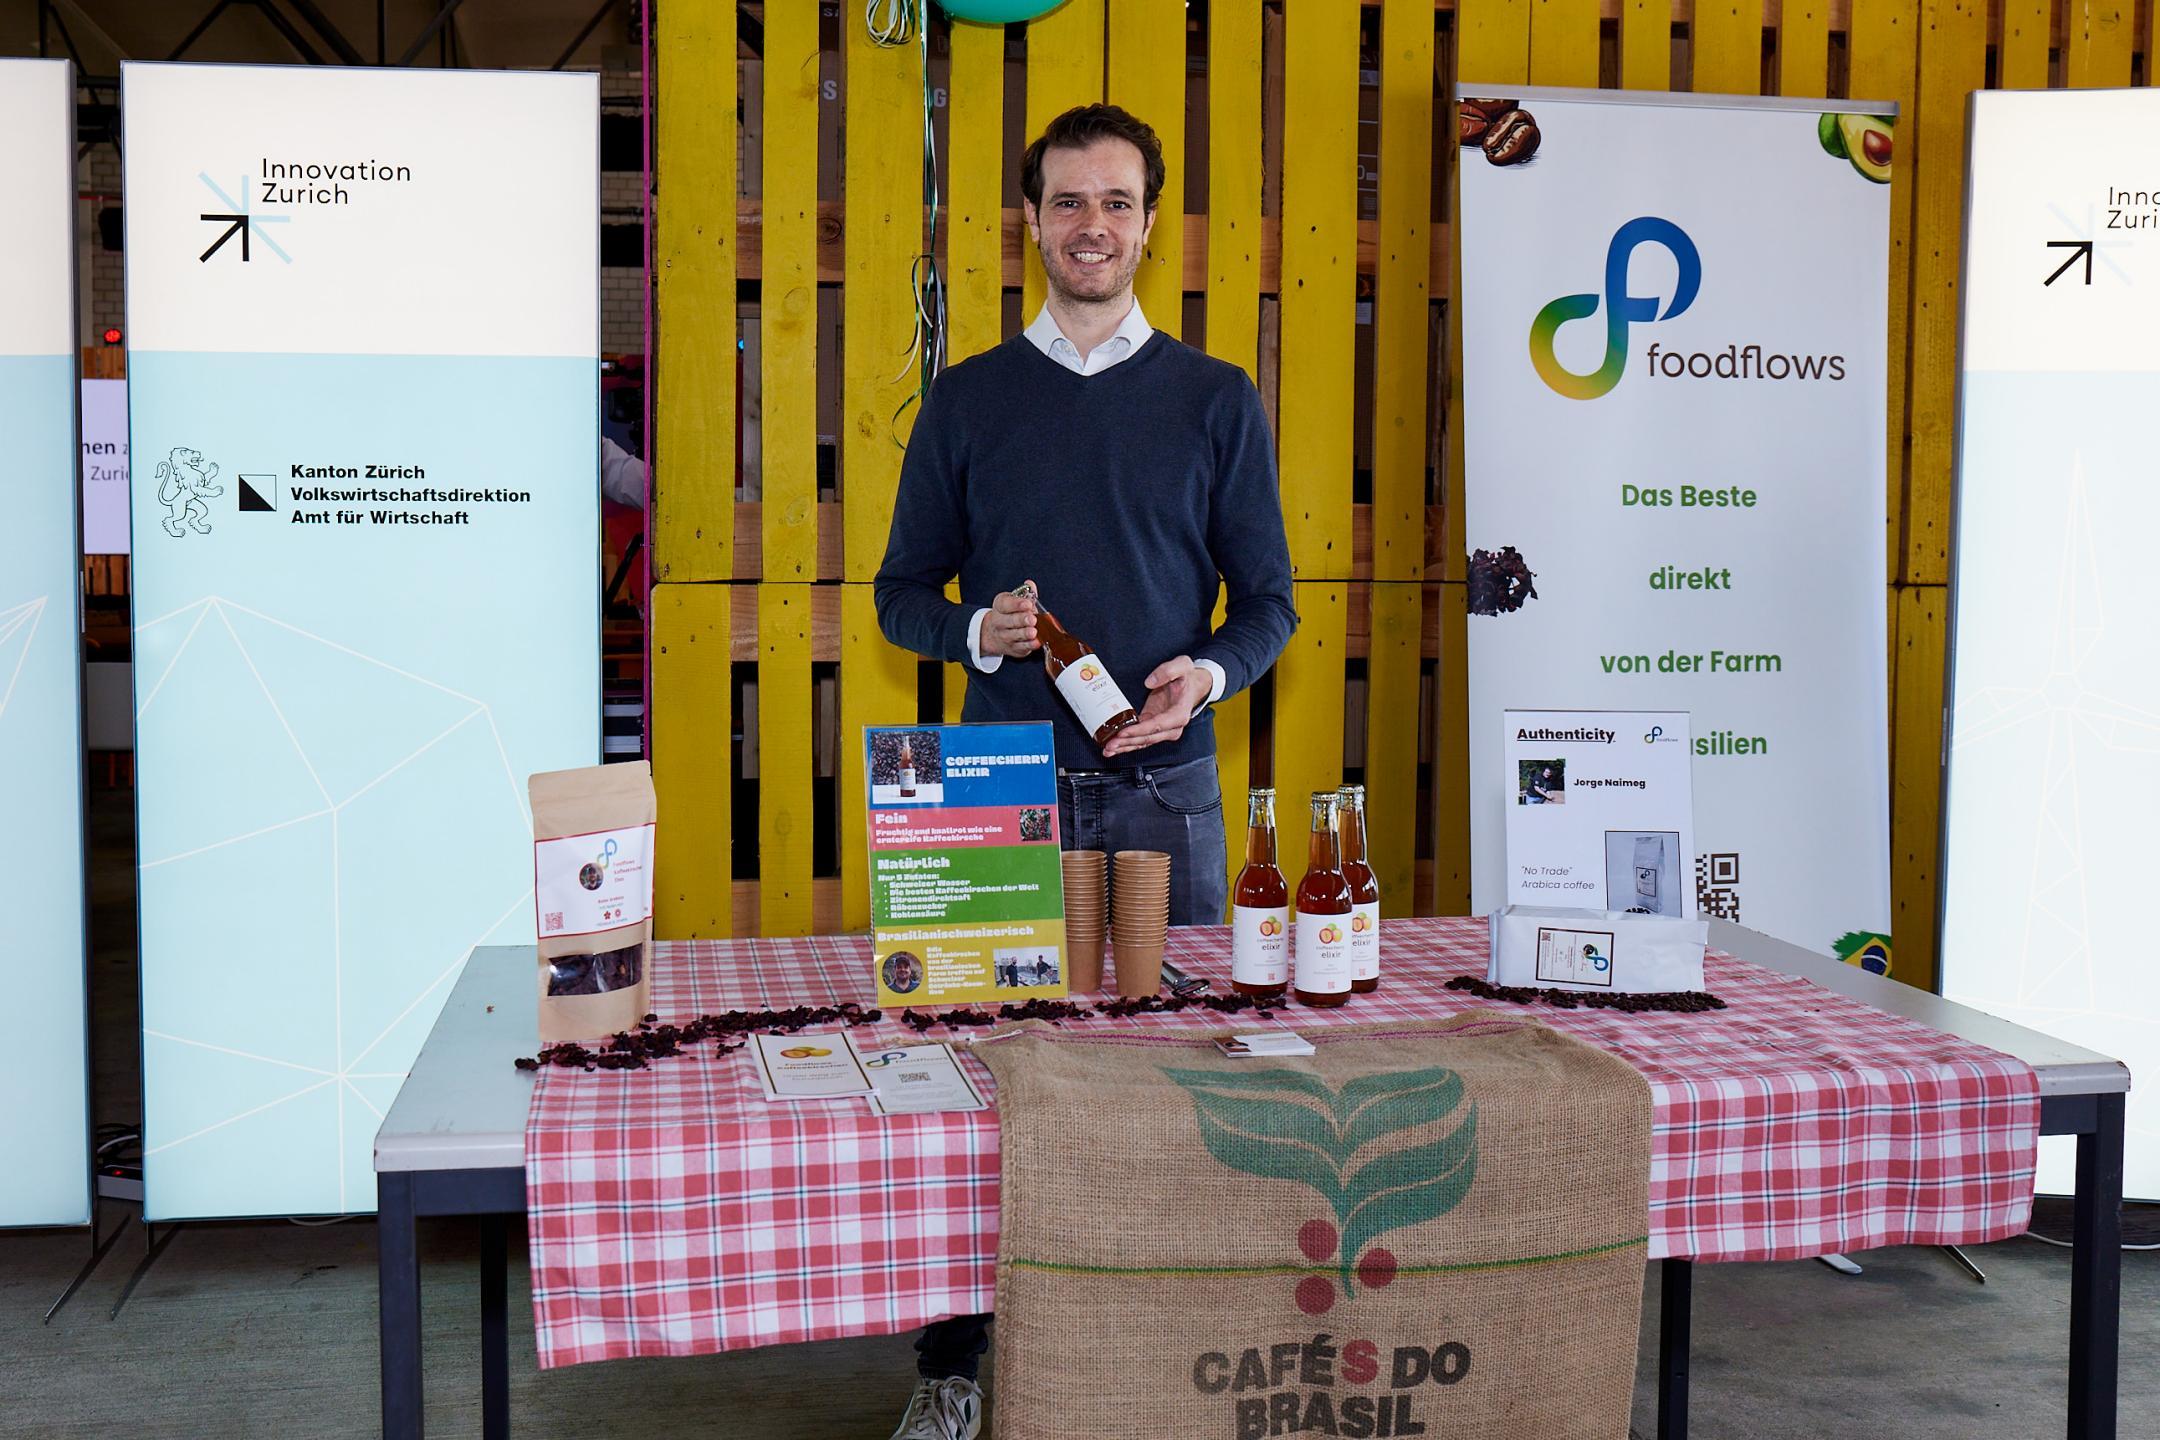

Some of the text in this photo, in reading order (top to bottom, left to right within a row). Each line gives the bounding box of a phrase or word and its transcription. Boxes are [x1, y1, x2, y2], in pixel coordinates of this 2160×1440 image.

[263, 158, 411, 181] Innovation
[262, 182, 348, 204] Zurich
[2107, 208, 2158, 229] Zuri
[1647, 343, 1846, 381] foodflows
[291, 464, 425, 479] Kanton Zürich
[291, 487, 531, 502] Volkswirtschaftsdirektion
[1622, 484, 1757, 508] Das Beste
[291, 510, 469, 525] Amt für Wirtschaft
[1649, 565, 1731, 590] direkt
[1600, 650, 1782, 673] von der Farm
[1516, 728, 1615, 744] Authenticity
[1690, 730, 1768, 756] silien
[945, 754, 1049, 767] COFFEECHERRY
[946, 767, 990, 778] ELIXIR
[1573, 778, 1646, 789] Jorge Naimeg
[875, 813, 908, 825] Fein
[875, 828, 914, 838] Fruchtig
[967, 826, 984, 834] wie
[984, 825, 1003, 833] eine
[923, 834, 984, 843] Kaffeekirsche
[877, 857, 950, 870] Natürlich
[878, 873, 895, 882] Nur
[903, 872, 940, 881] Zutaten:
[1521, 866, 1573, 876] "No Trade"
[889, 879, 971, 889] Schweizer Wasser
[889, 883, 1040, 896] Die besten Kaffeekirschen der Welt
[1521, 880, 1595, 890] Arabica coffee
[889, 894, 972, 904] Zitronendirektsaft
[890, 902, 948, 912] Rübenzucker
[890, 910, 946, 919] Kohlensäure
[877, 926, 1035, 942] Brasilianischweizerisch
[1262, 943, 1281, 951] elixir
[1352, 938, 1371, 947] elixir
[1321, 951, 1341, 959] elixir
[1193, 1334, 1471, 1394] CAFÉS DO
[1236, 1392, 1426, 1440] BRASIL
